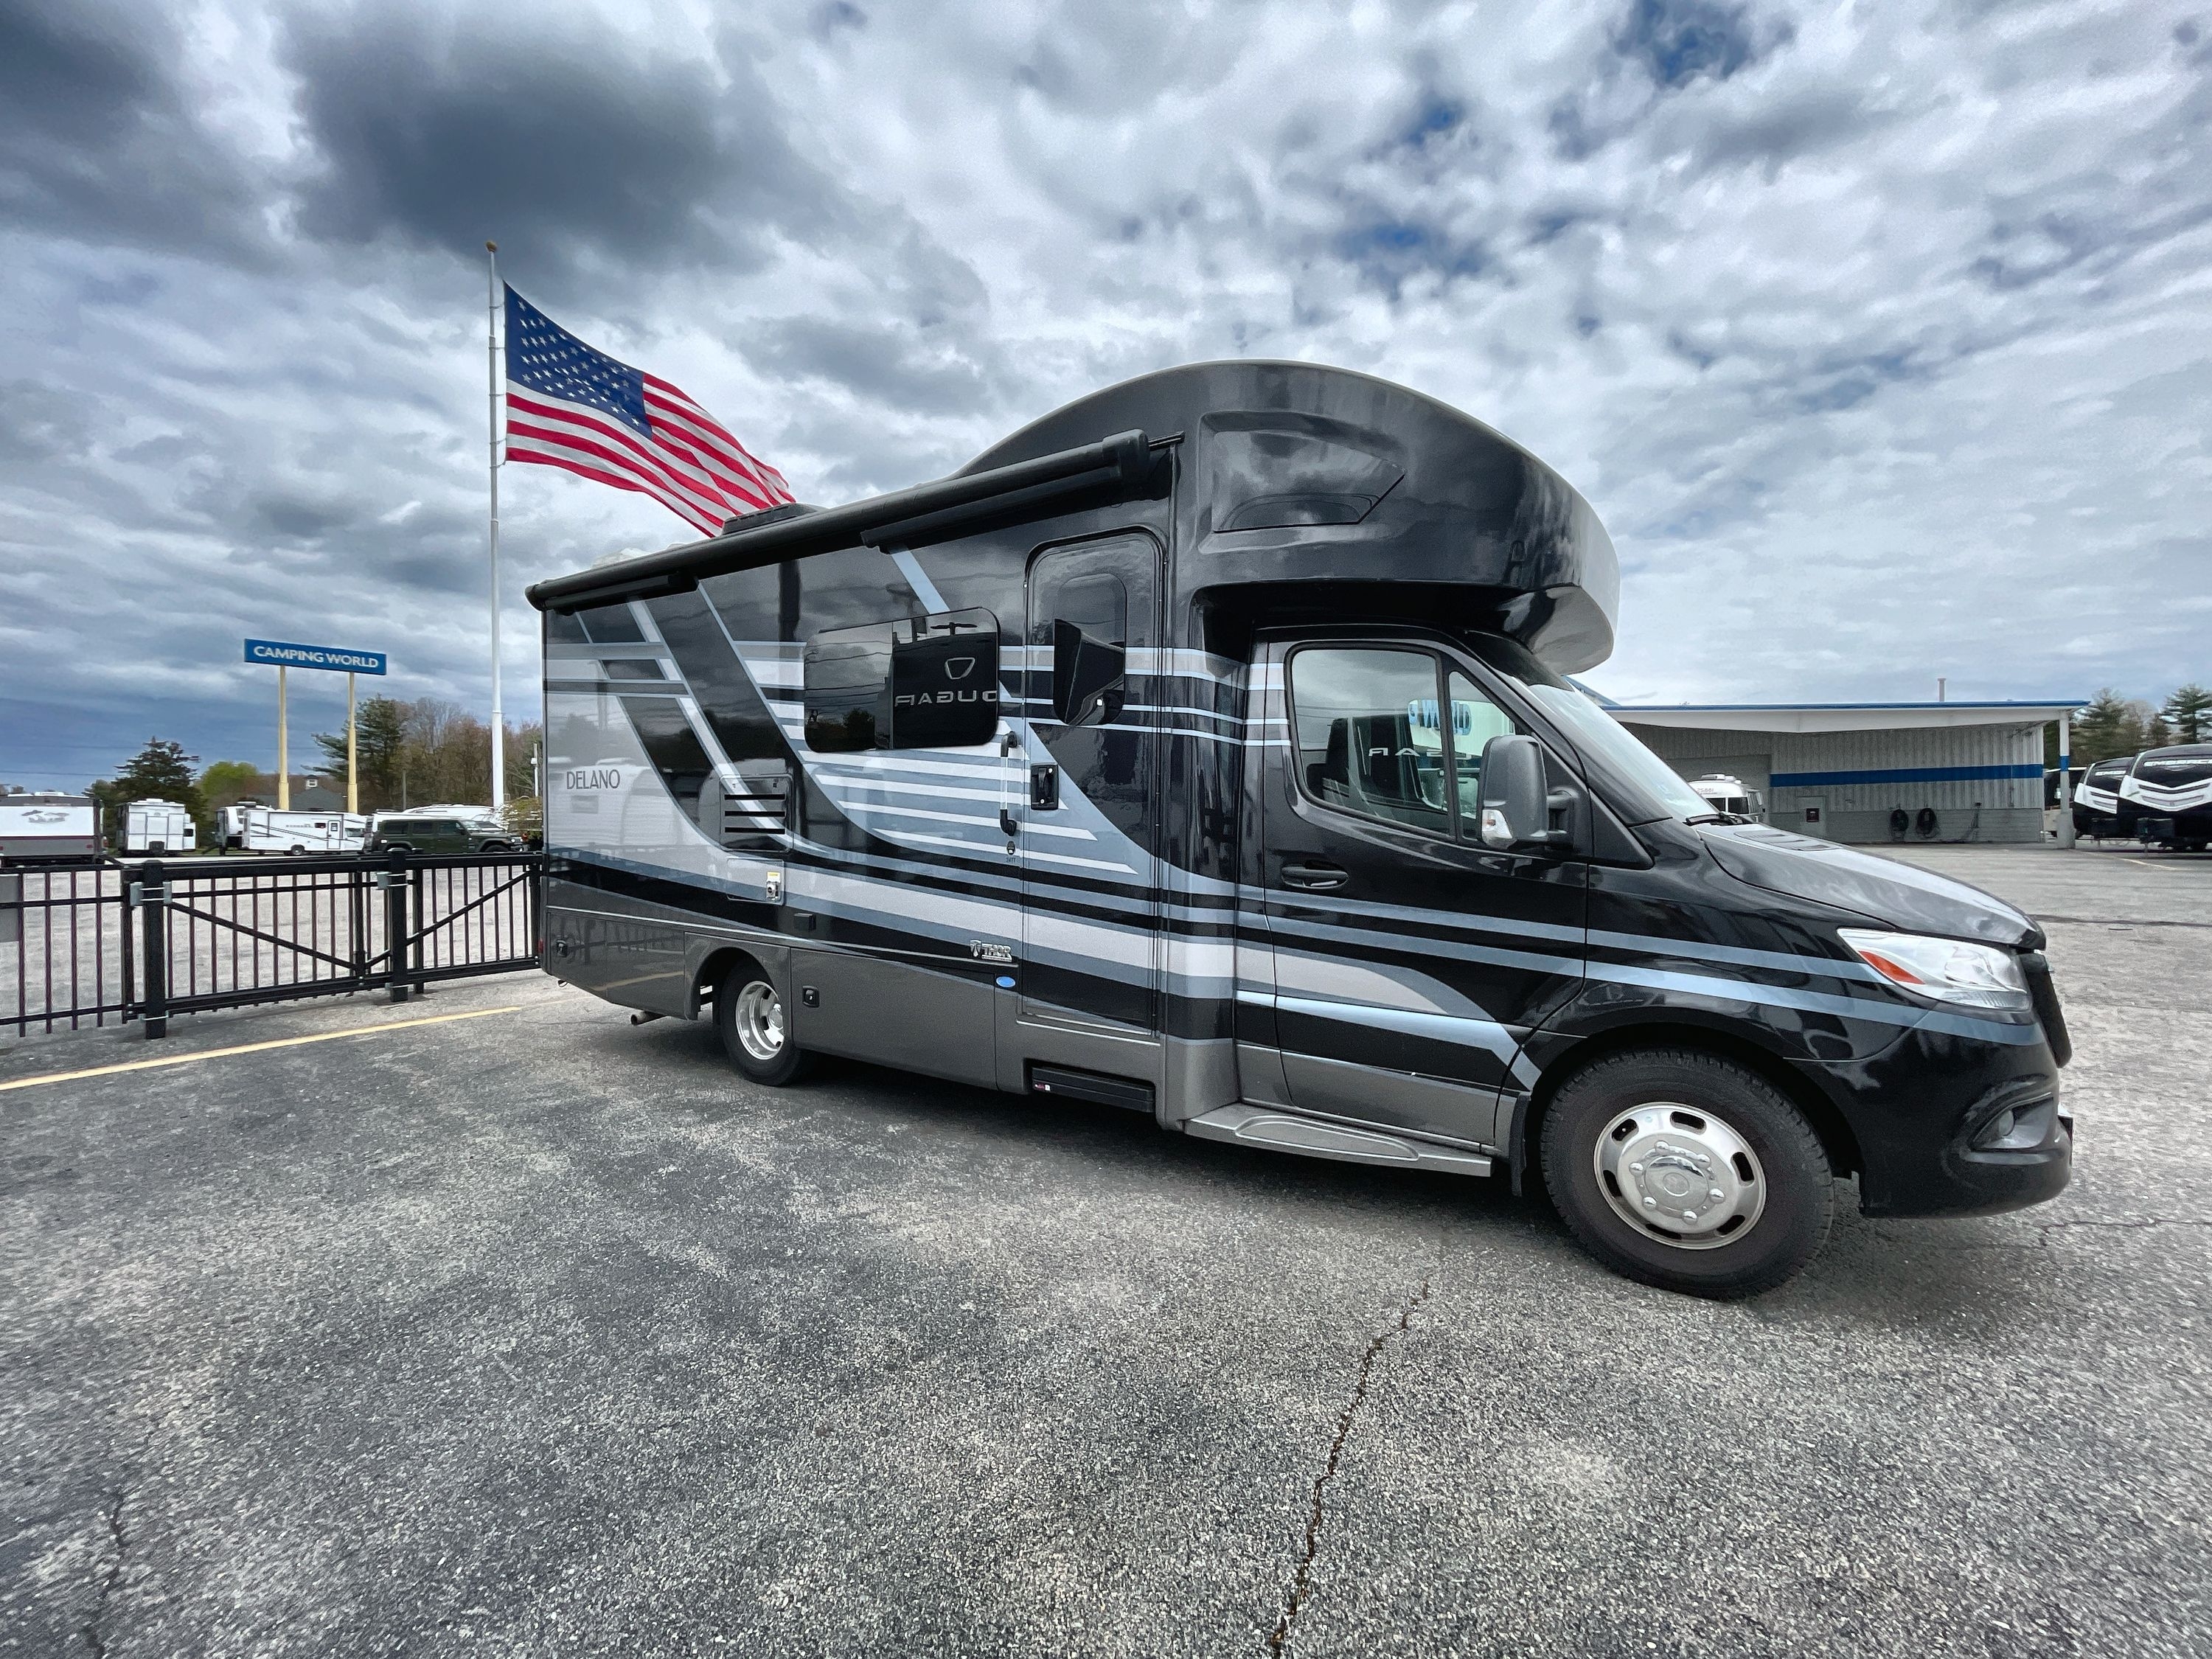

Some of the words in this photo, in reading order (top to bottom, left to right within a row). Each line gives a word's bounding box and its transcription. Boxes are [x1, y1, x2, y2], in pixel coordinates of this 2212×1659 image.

[253, 646, 324, 663] CAMPING
[325, 653, 379, 668] WORLD
[566, 769, 621, 790] DELANO
[981, 943, 1012, 959] THOR
